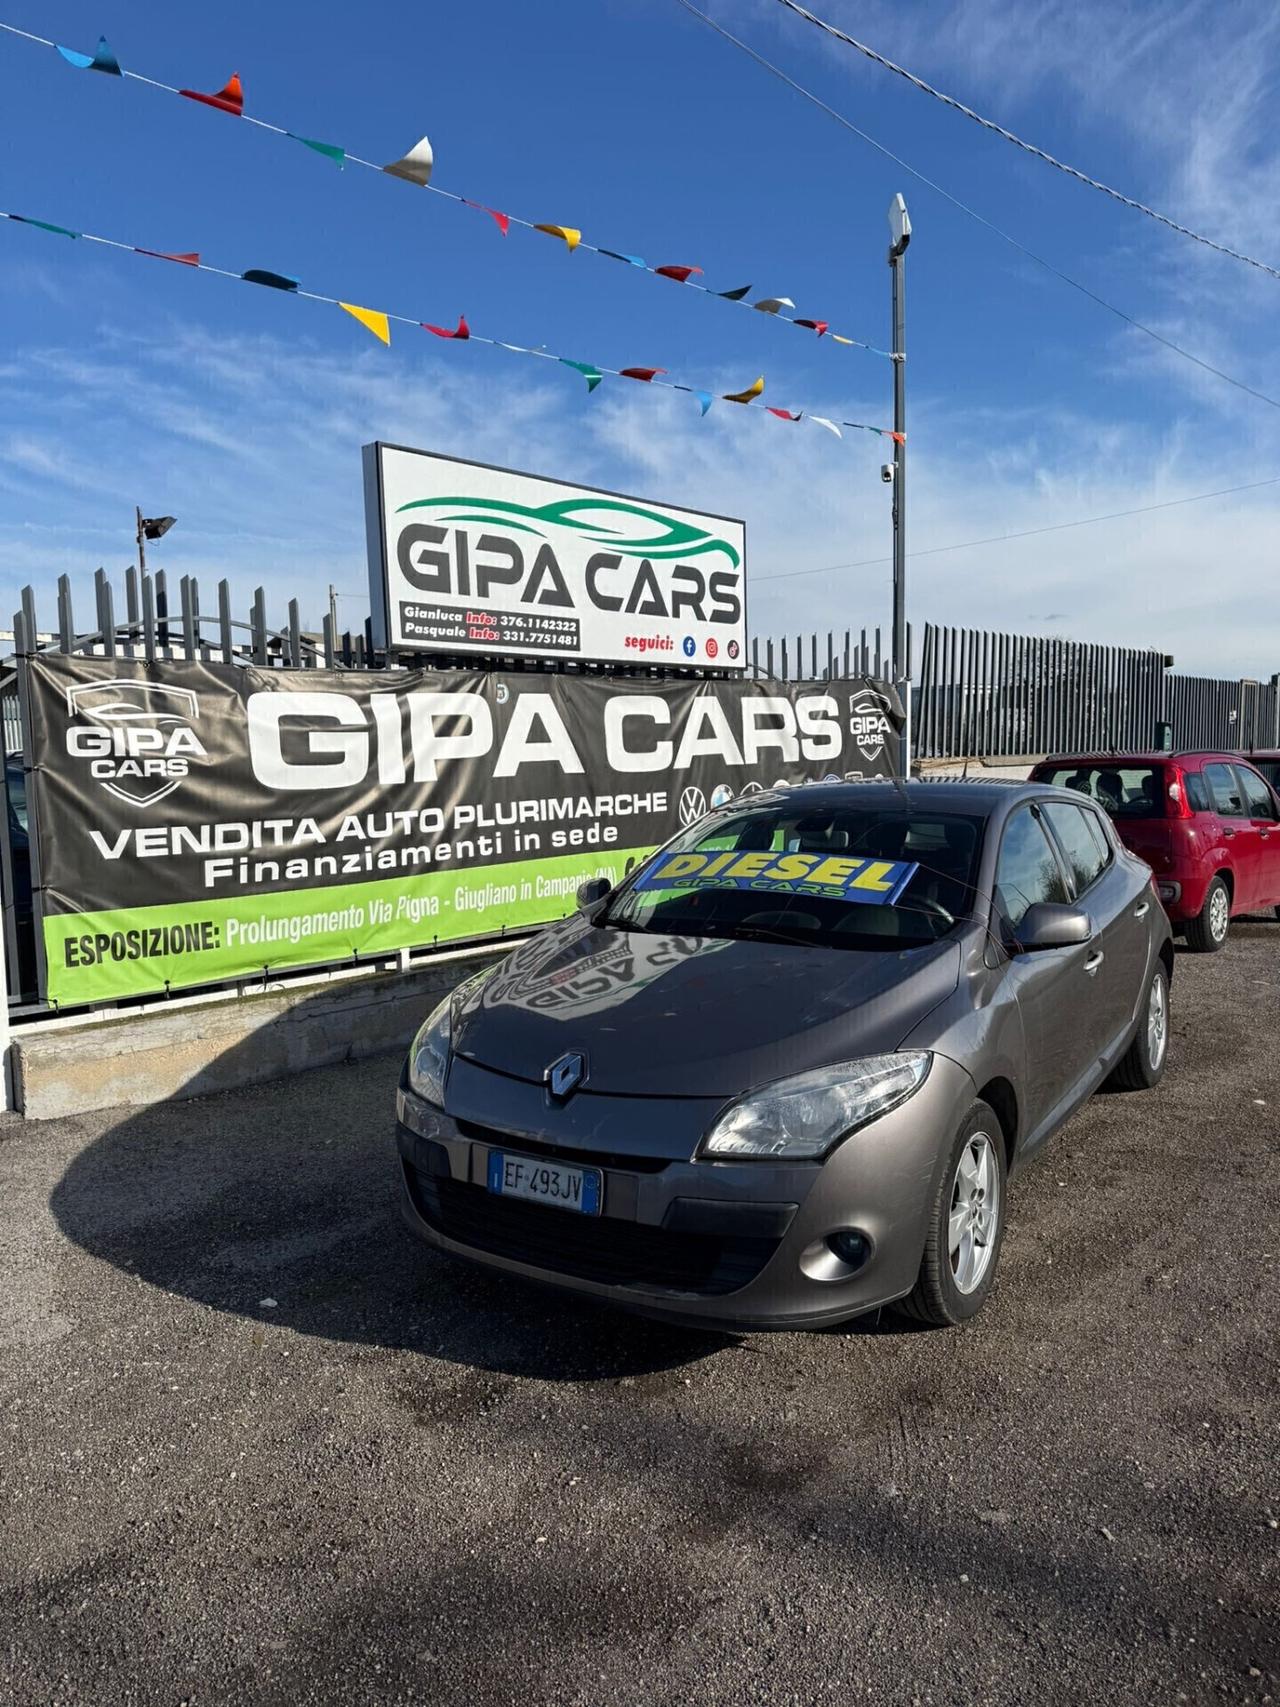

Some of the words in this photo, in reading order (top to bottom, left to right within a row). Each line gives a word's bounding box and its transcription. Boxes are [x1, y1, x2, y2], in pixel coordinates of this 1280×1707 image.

[397, 523, 575, 608] GIPA
[585, 552, 741, 625] CARS
[404, 606, 463, 622] Gianluca
[466, 611, 498, 626] Info:
[500, 616, 577, 632] 376.1142322
[405, 622, 466, 638] Pasquale
[469, 627, 500, 640] Info:
[502, 631, 578, 646] 331.7751481
[624, 634, 674, 653] seguici:
[850, 716, 892, 735] GIPA
[66, 726, 208, 757] GIPA
[247, 692, 586, 790] GIPA
[603, 694, 843, 773] CARS
[856, 734, 885, 746] CARS
[91, 759, 189, 778] CARS
[89, 818, 326, 860] VENDITA
[336, 806, 445, 842] AUTO
[454, 791, 668, 829] PLURIMARCHE
[204, 831, 502, 888] Finanziamenti
[514, 830, 541, 853] in
[551, 822, 619, 848] sede
[652, 852, 895, 892] DIESEL
[673, 878, 738, 888] GIPA
[750, 881, 847, 897] CARS
[64, 920, 221, 968] ESPOSIZIONE:
[226, 906, 365, 947] Prolungamento
[368, 897, 393, 925] Via
[396, 889, 440, 923] Pigna
[456, 880, 516, 913] Giugliano
[520, 877, 533, 900] in
